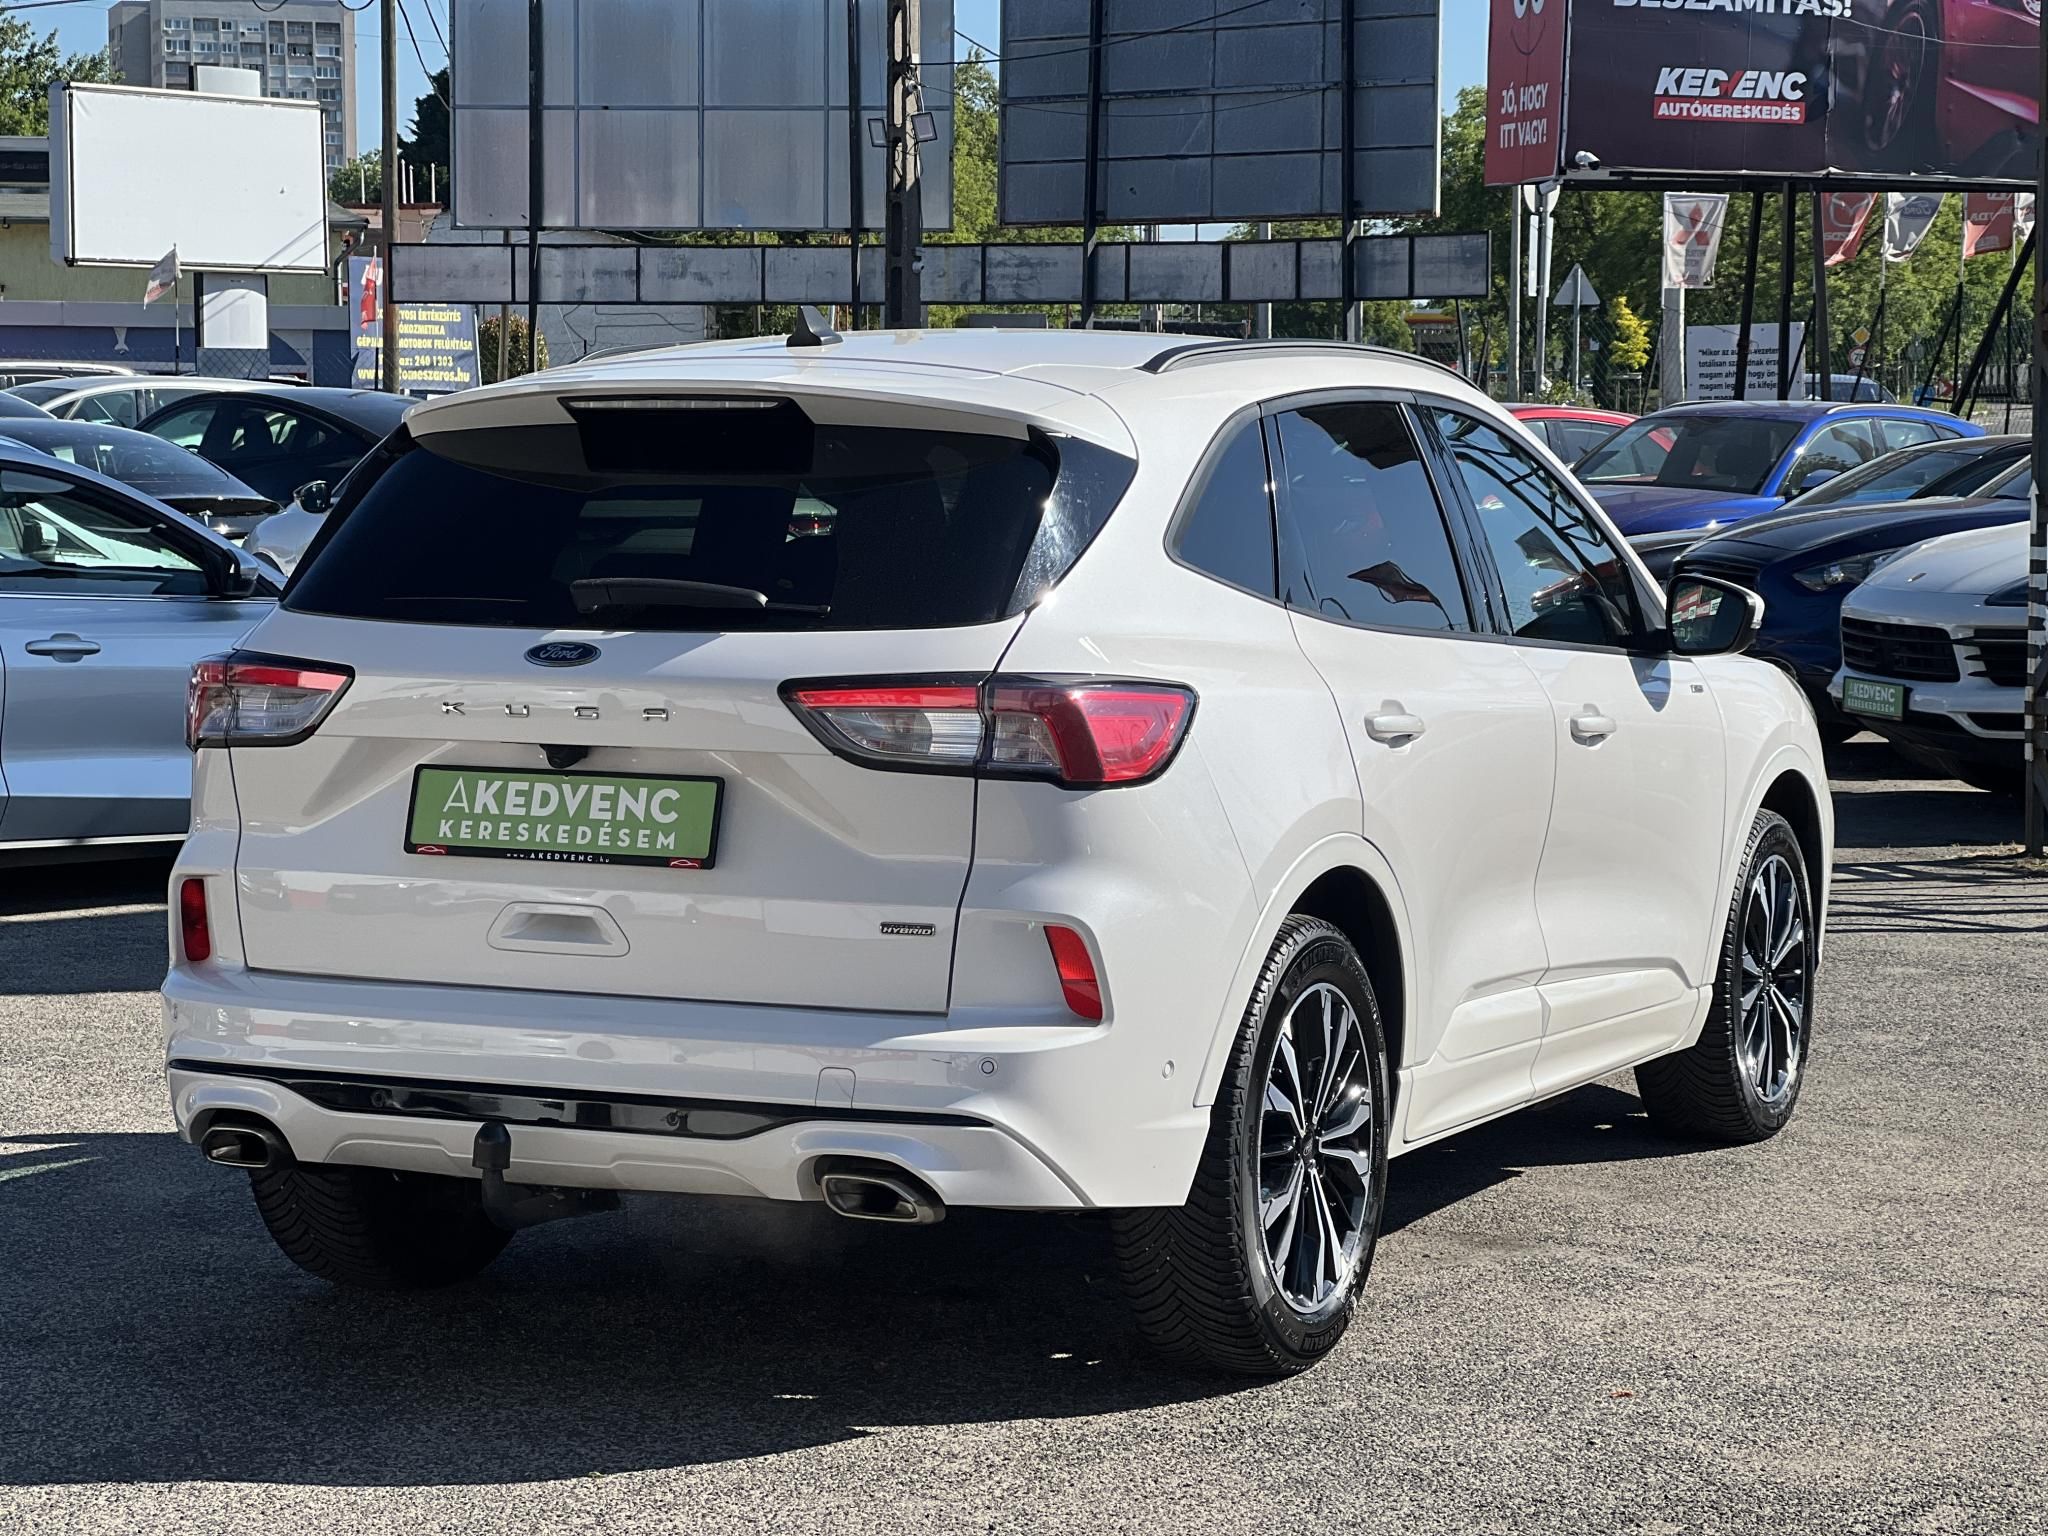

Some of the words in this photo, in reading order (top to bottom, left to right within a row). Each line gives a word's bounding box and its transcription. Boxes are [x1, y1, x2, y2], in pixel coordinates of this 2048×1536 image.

[1654, 67, 1807, 100] KEDVENC
[1501, 81, 1518, 117] JÓ,
[1520, 82, 1548, 112] HOGY
[1657, 101, 1801, 121] AUTÓKERESKEDÉS
[1500, 123, 1516, 149] ITT
[1518, 118, 1547, 146] VAGY!
[399, 322, 446, 335] ÓKOZMETIKA
[414, 355, 431, 366] 240
[433, 355, 454, 367] 1303
[1748, 370, 1765, 379] hogy
[442, 701, 669, 721] KUGA
[439, 819, 676, 850] KERESKEDÉSEM
[883, 927, 932, 935] HYBRID
